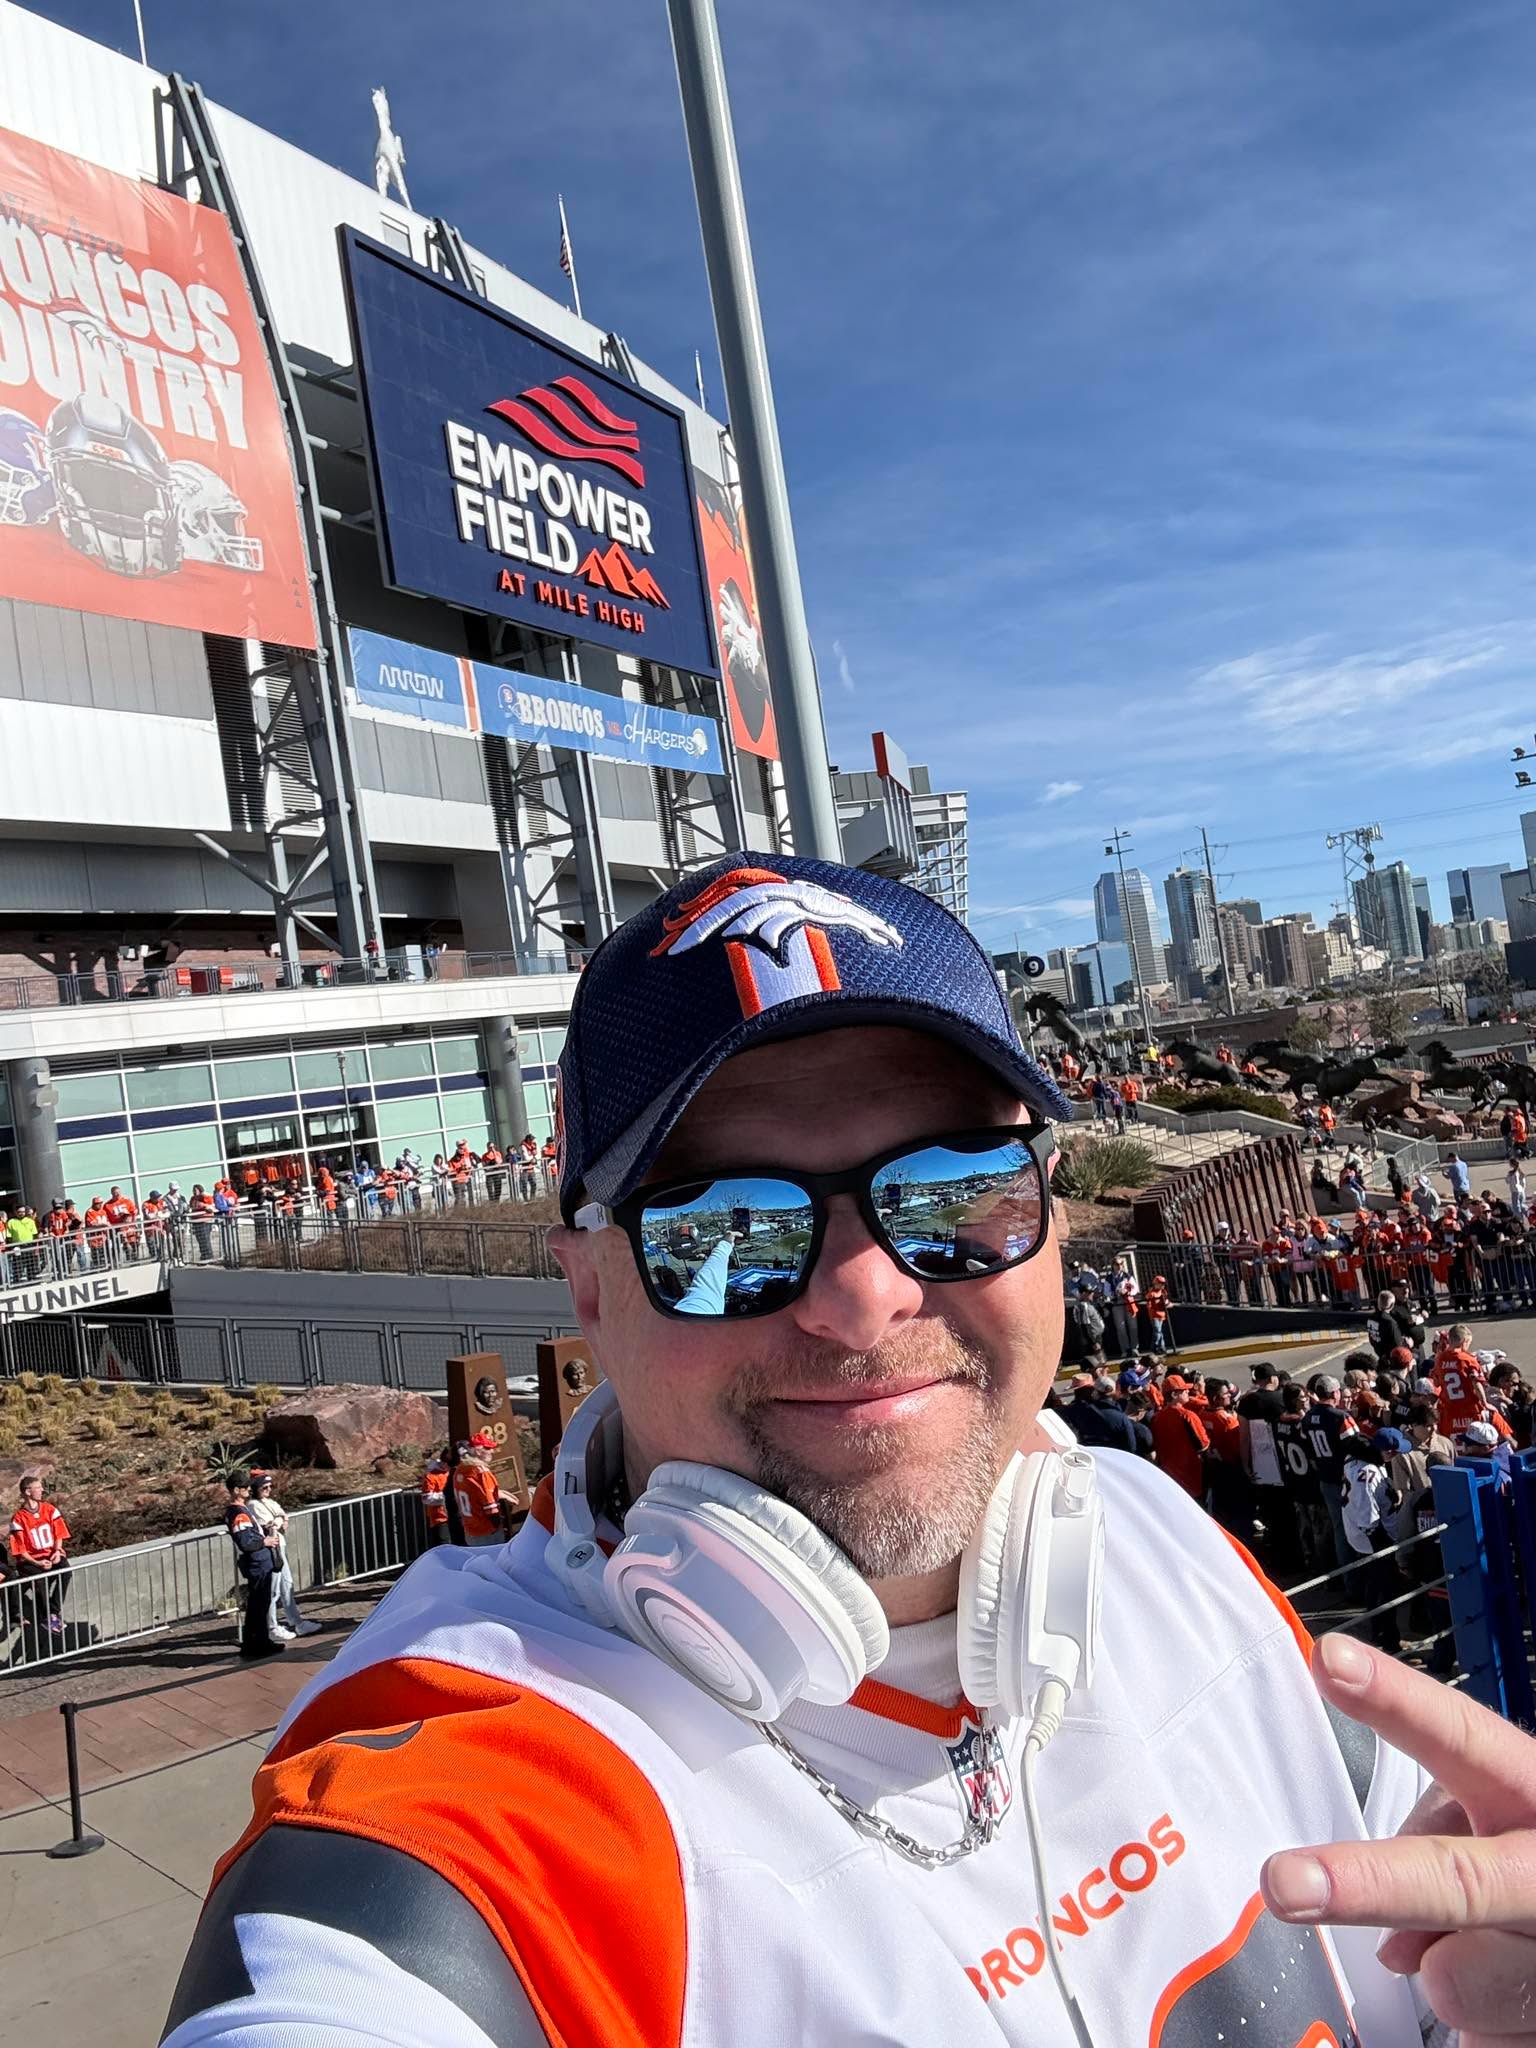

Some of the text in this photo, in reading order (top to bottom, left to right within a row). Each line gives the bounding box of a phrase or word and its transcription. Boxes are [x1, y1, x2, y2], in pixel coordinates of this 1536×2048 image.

[446, 420, 655, 554] EMPOWER
[455, 484, 578, 574] FIELD
[500, 569, 645, 633] AT MILE HIGH
[379, 663, 444, 700] ARROW
[516, 691, 606, 739] BRONCOS
[1028, 960, 1040, 974] 9
[0, 1276, 129, 1318] TUNNEL
[1443, 1372, 1465, 1400] 2
[1308, 1429, 1333, 1458] 10
[30, 1522, 55, 1551] 10
[574, 1550, 587, 1560] R
